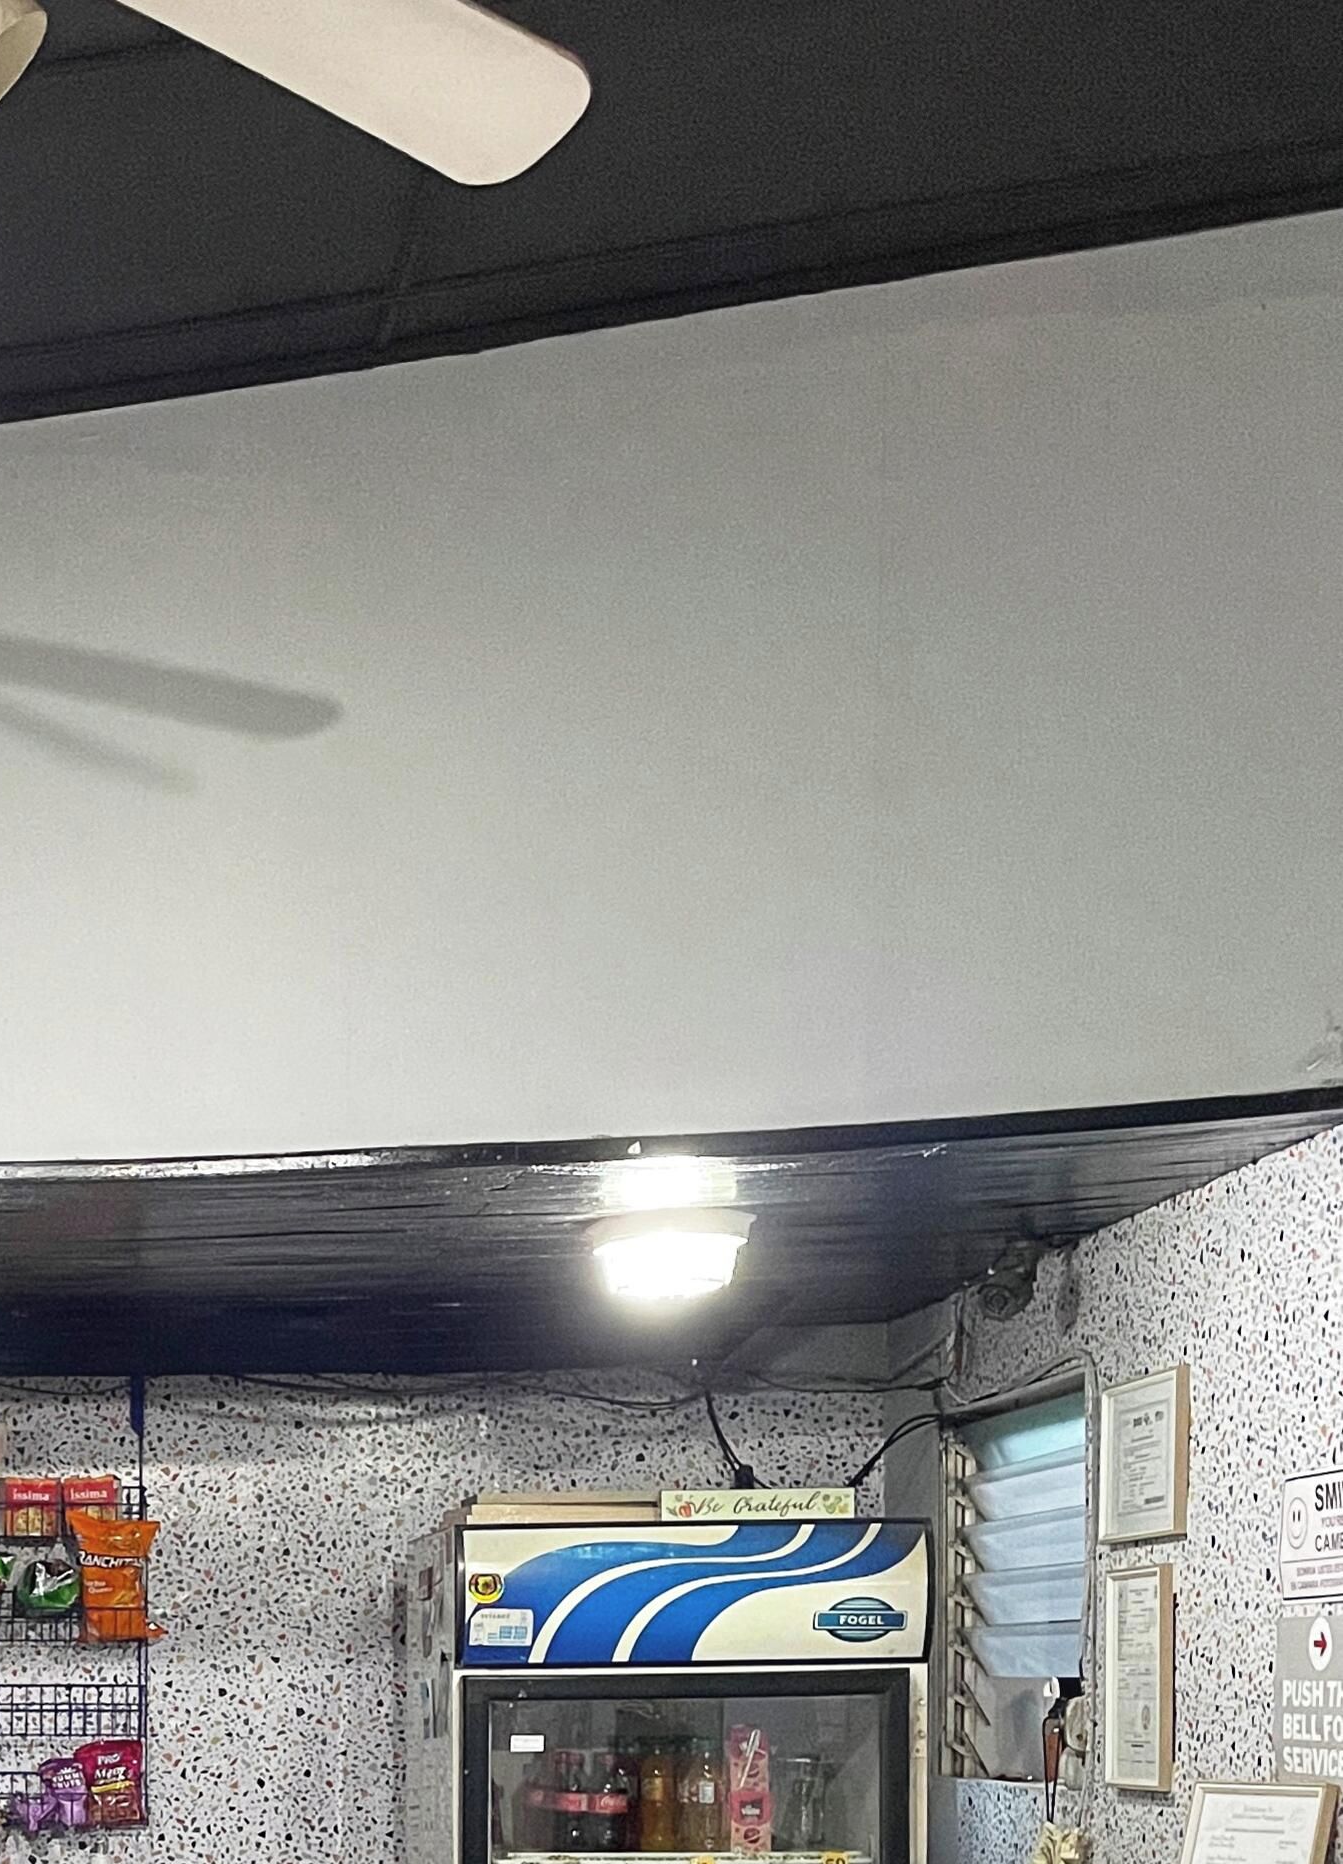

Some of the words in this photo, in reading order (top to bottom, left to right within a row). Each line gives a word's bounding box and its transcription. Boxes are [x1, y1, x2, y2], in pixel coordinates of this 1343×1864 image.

[733, 1490, 821, 1518] Grateful
[1314, 1481, 1343, 1512] SMI
[838, 1614, 885, 1626] FOGEL
[1282, 1679, 1324, 1707] PUSH
[1282, 1712, 1322, 1742] BELL
